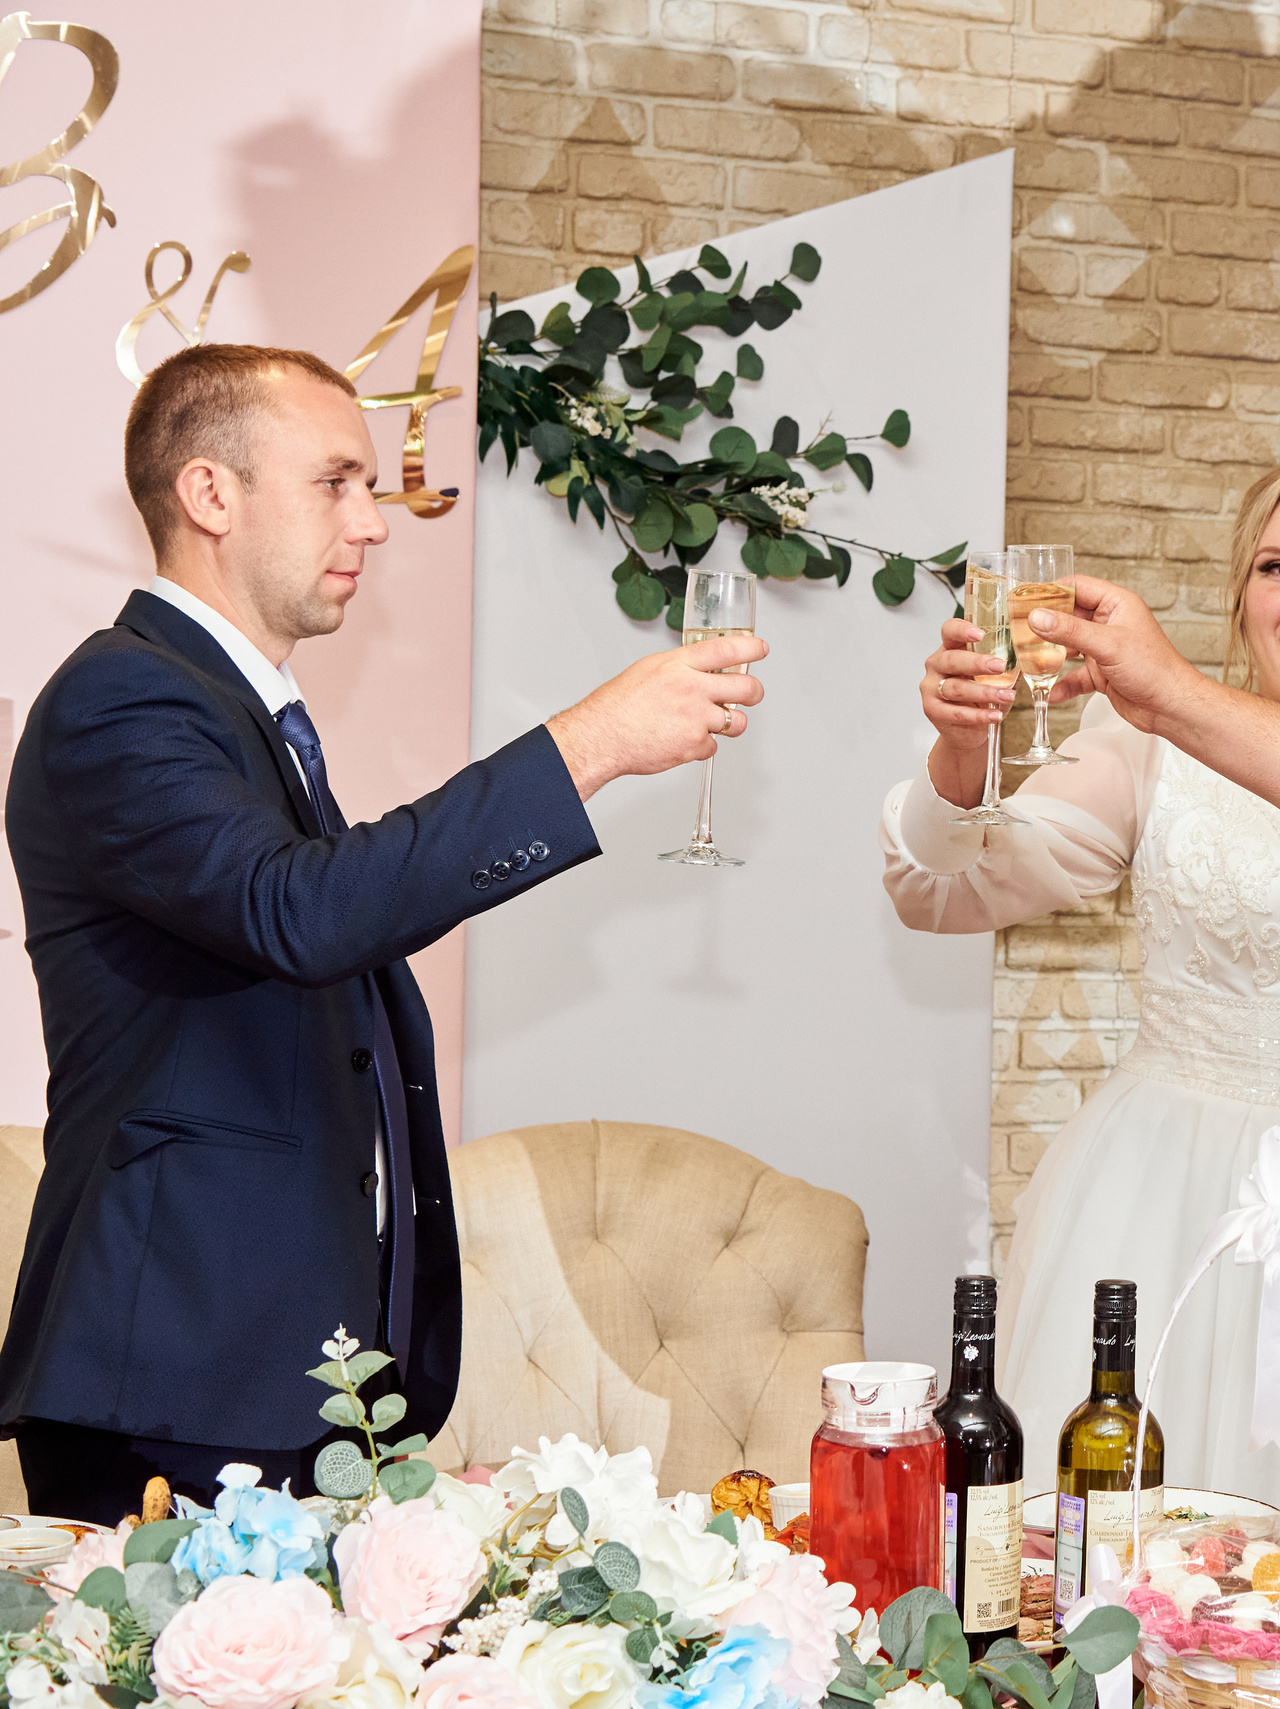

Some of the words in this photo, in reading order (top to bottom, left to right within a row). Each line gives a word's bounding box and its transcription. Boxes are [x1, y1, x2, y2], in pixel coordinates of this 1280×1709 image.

[0, 11, 120, 315] B
[115, 241, 251, 389] &
[343, 244, 476, 519] A
[1103, 1510, 1125, 1528] Luigi
